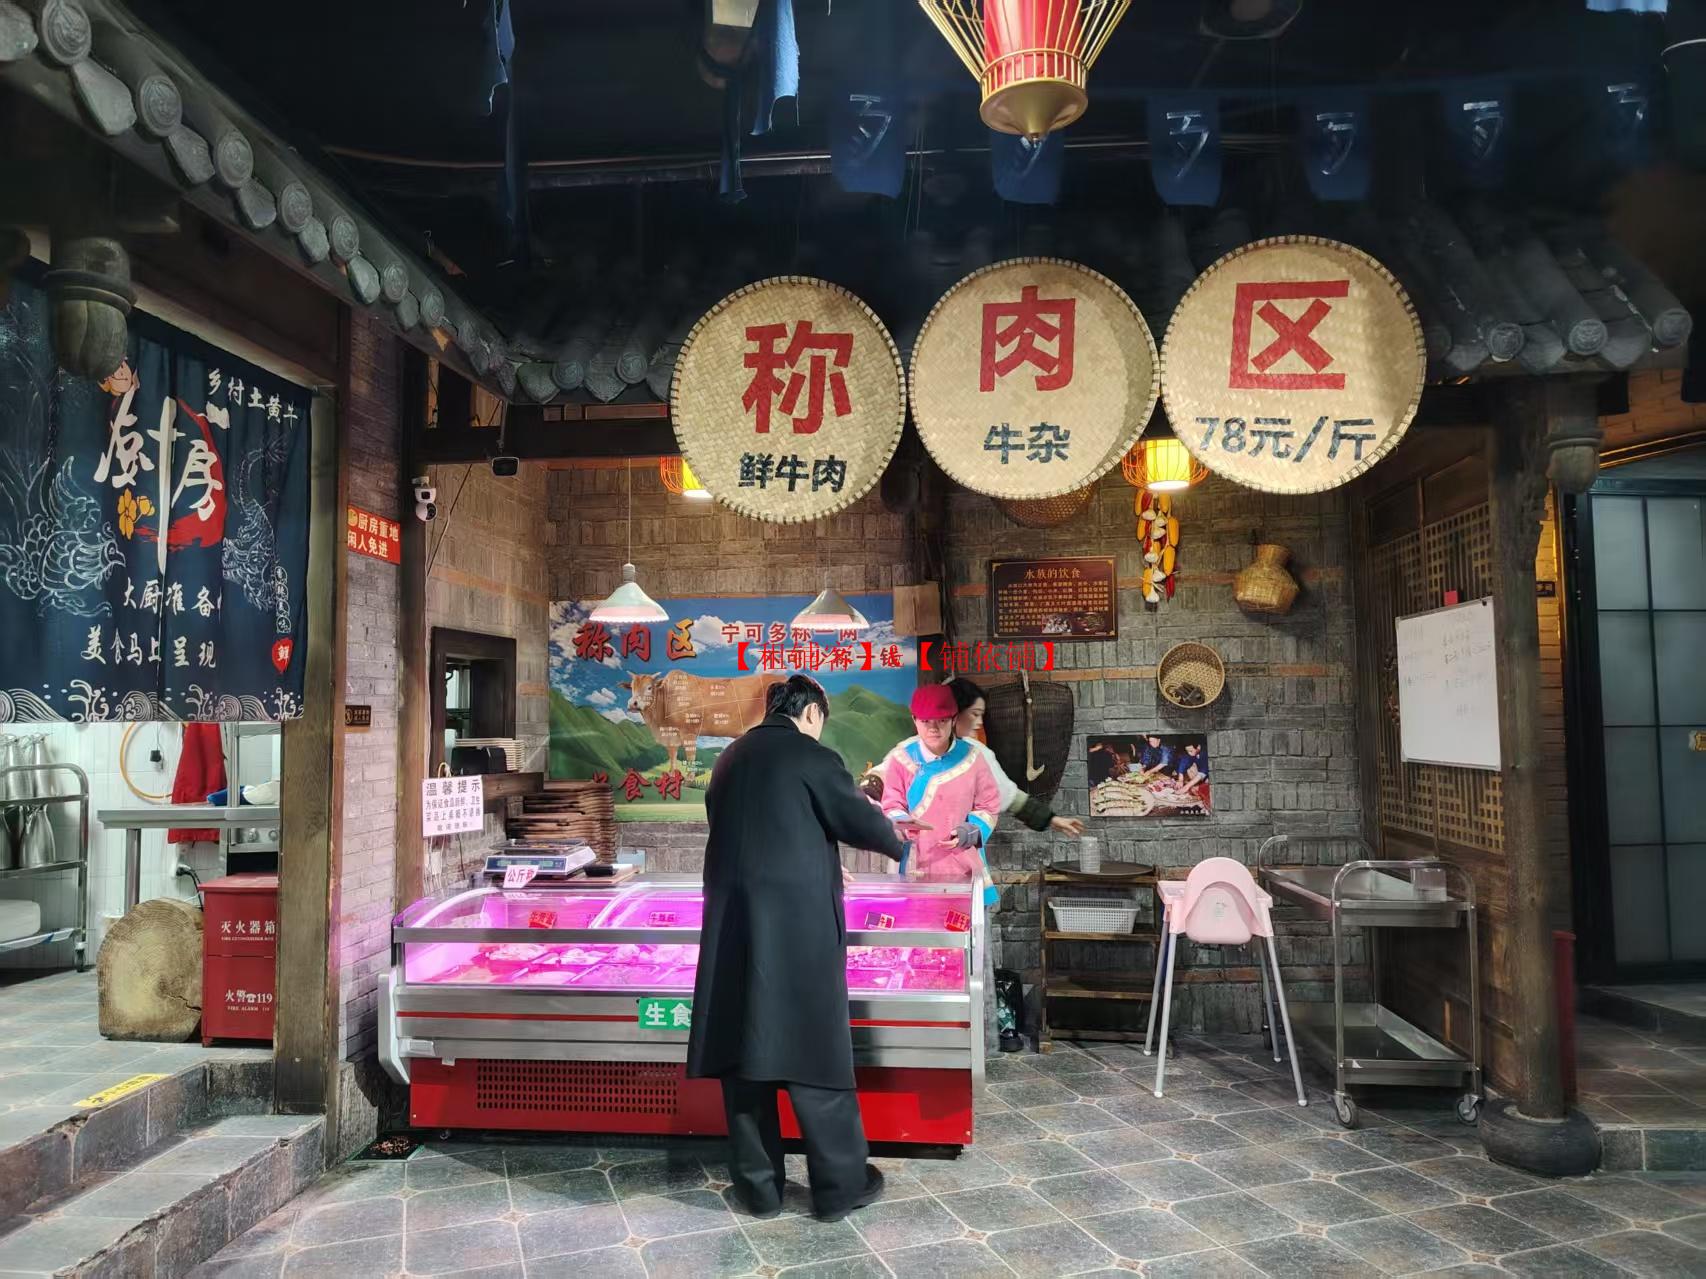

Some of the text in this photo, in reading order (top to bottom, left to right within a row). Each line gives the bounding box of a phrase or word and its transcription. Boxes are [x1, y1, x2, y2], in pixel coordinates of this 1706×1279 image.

[741, 280, 1350, 434] 称 肉 区
[208, 367, 298, 430] 乡村土黄牛
[984, 422, 1070, 464] 牛杂
[1195, 416, 1376, 463] 78元/斤
[738, 452, 848, 492] 鲜牛肉
[347, 530, 388, 558] 闲人免进
[358, 512, 399, 542] 厨房重地
[1025, 567, 1081, 580] 水族的饮食
[123, 577, 215, 618] 大厨准备
[81, 624, 216, 668] 美食马上呈现
[572, 618, 697, 663] 称肉区
[426, 779, 481, 796] 温馨提示
[221, 920, 276, 934] 灭火器箱
[257, 993, 273, 1004] 119
